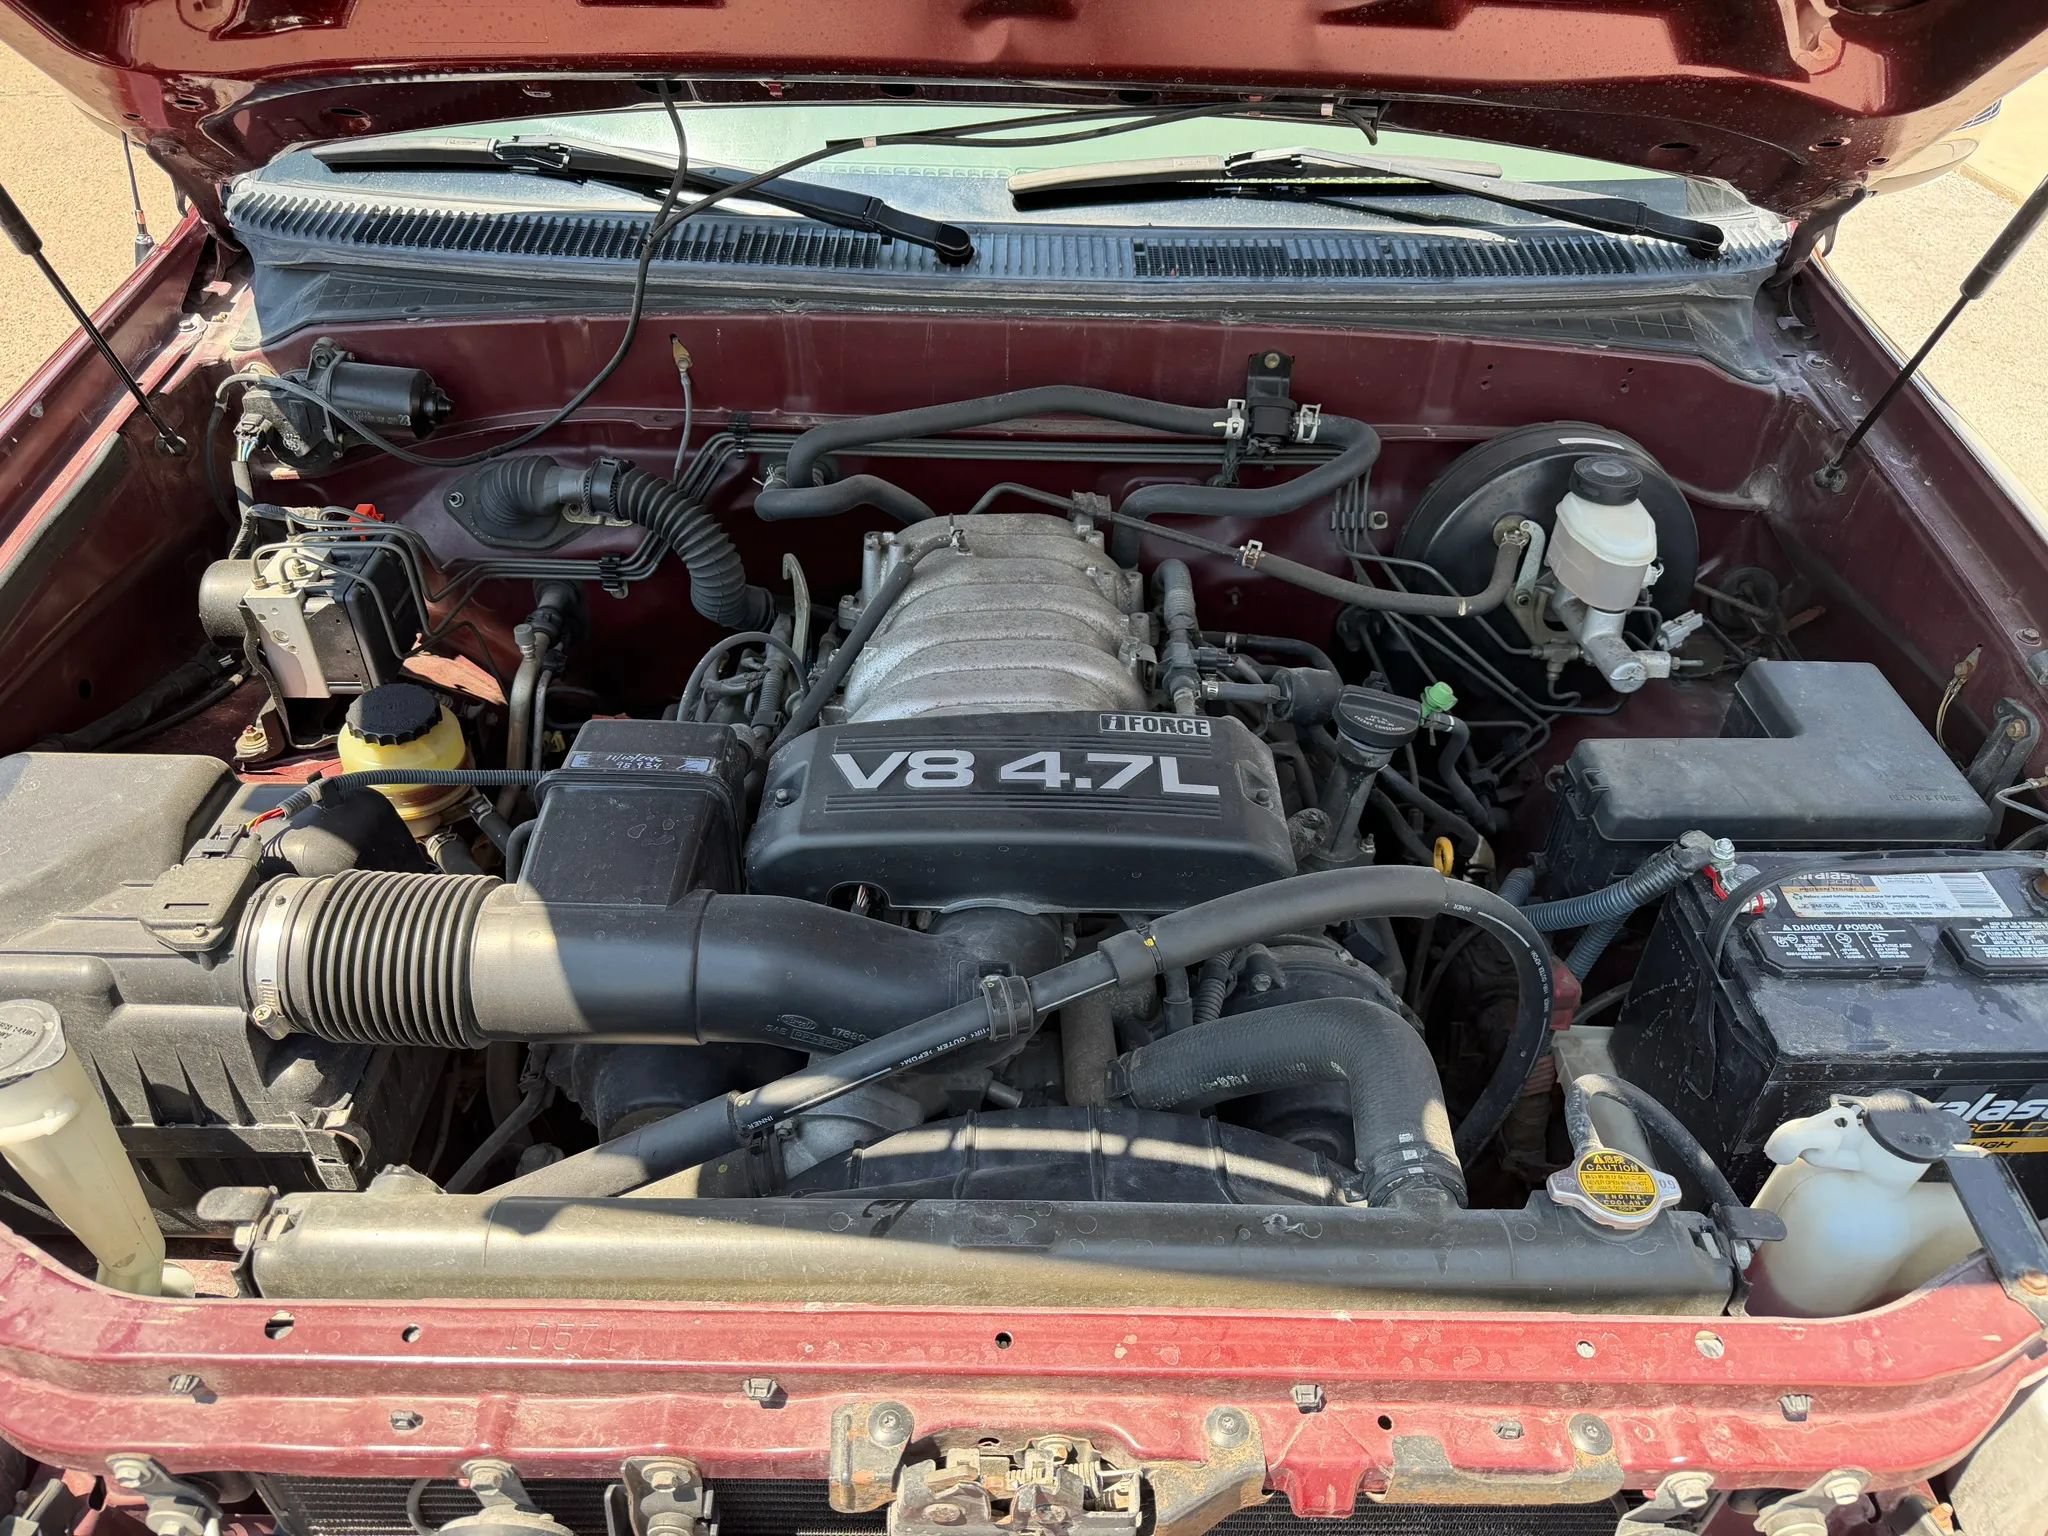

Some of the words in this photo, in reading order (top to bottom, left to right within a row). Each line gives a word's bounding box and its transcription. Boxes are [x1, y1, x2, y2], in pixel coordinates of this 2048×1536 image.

[832, 749, 976, 790] V8
[1000, 751, 1220, 796] 4.7L
[936, 1036, 967, 1054] OUTER
[1931, 1093, 2048, 1121] alas
[748, 1115, 774, 1130] INNER
[1586, 1163, 1639, 1172] CAUTION
